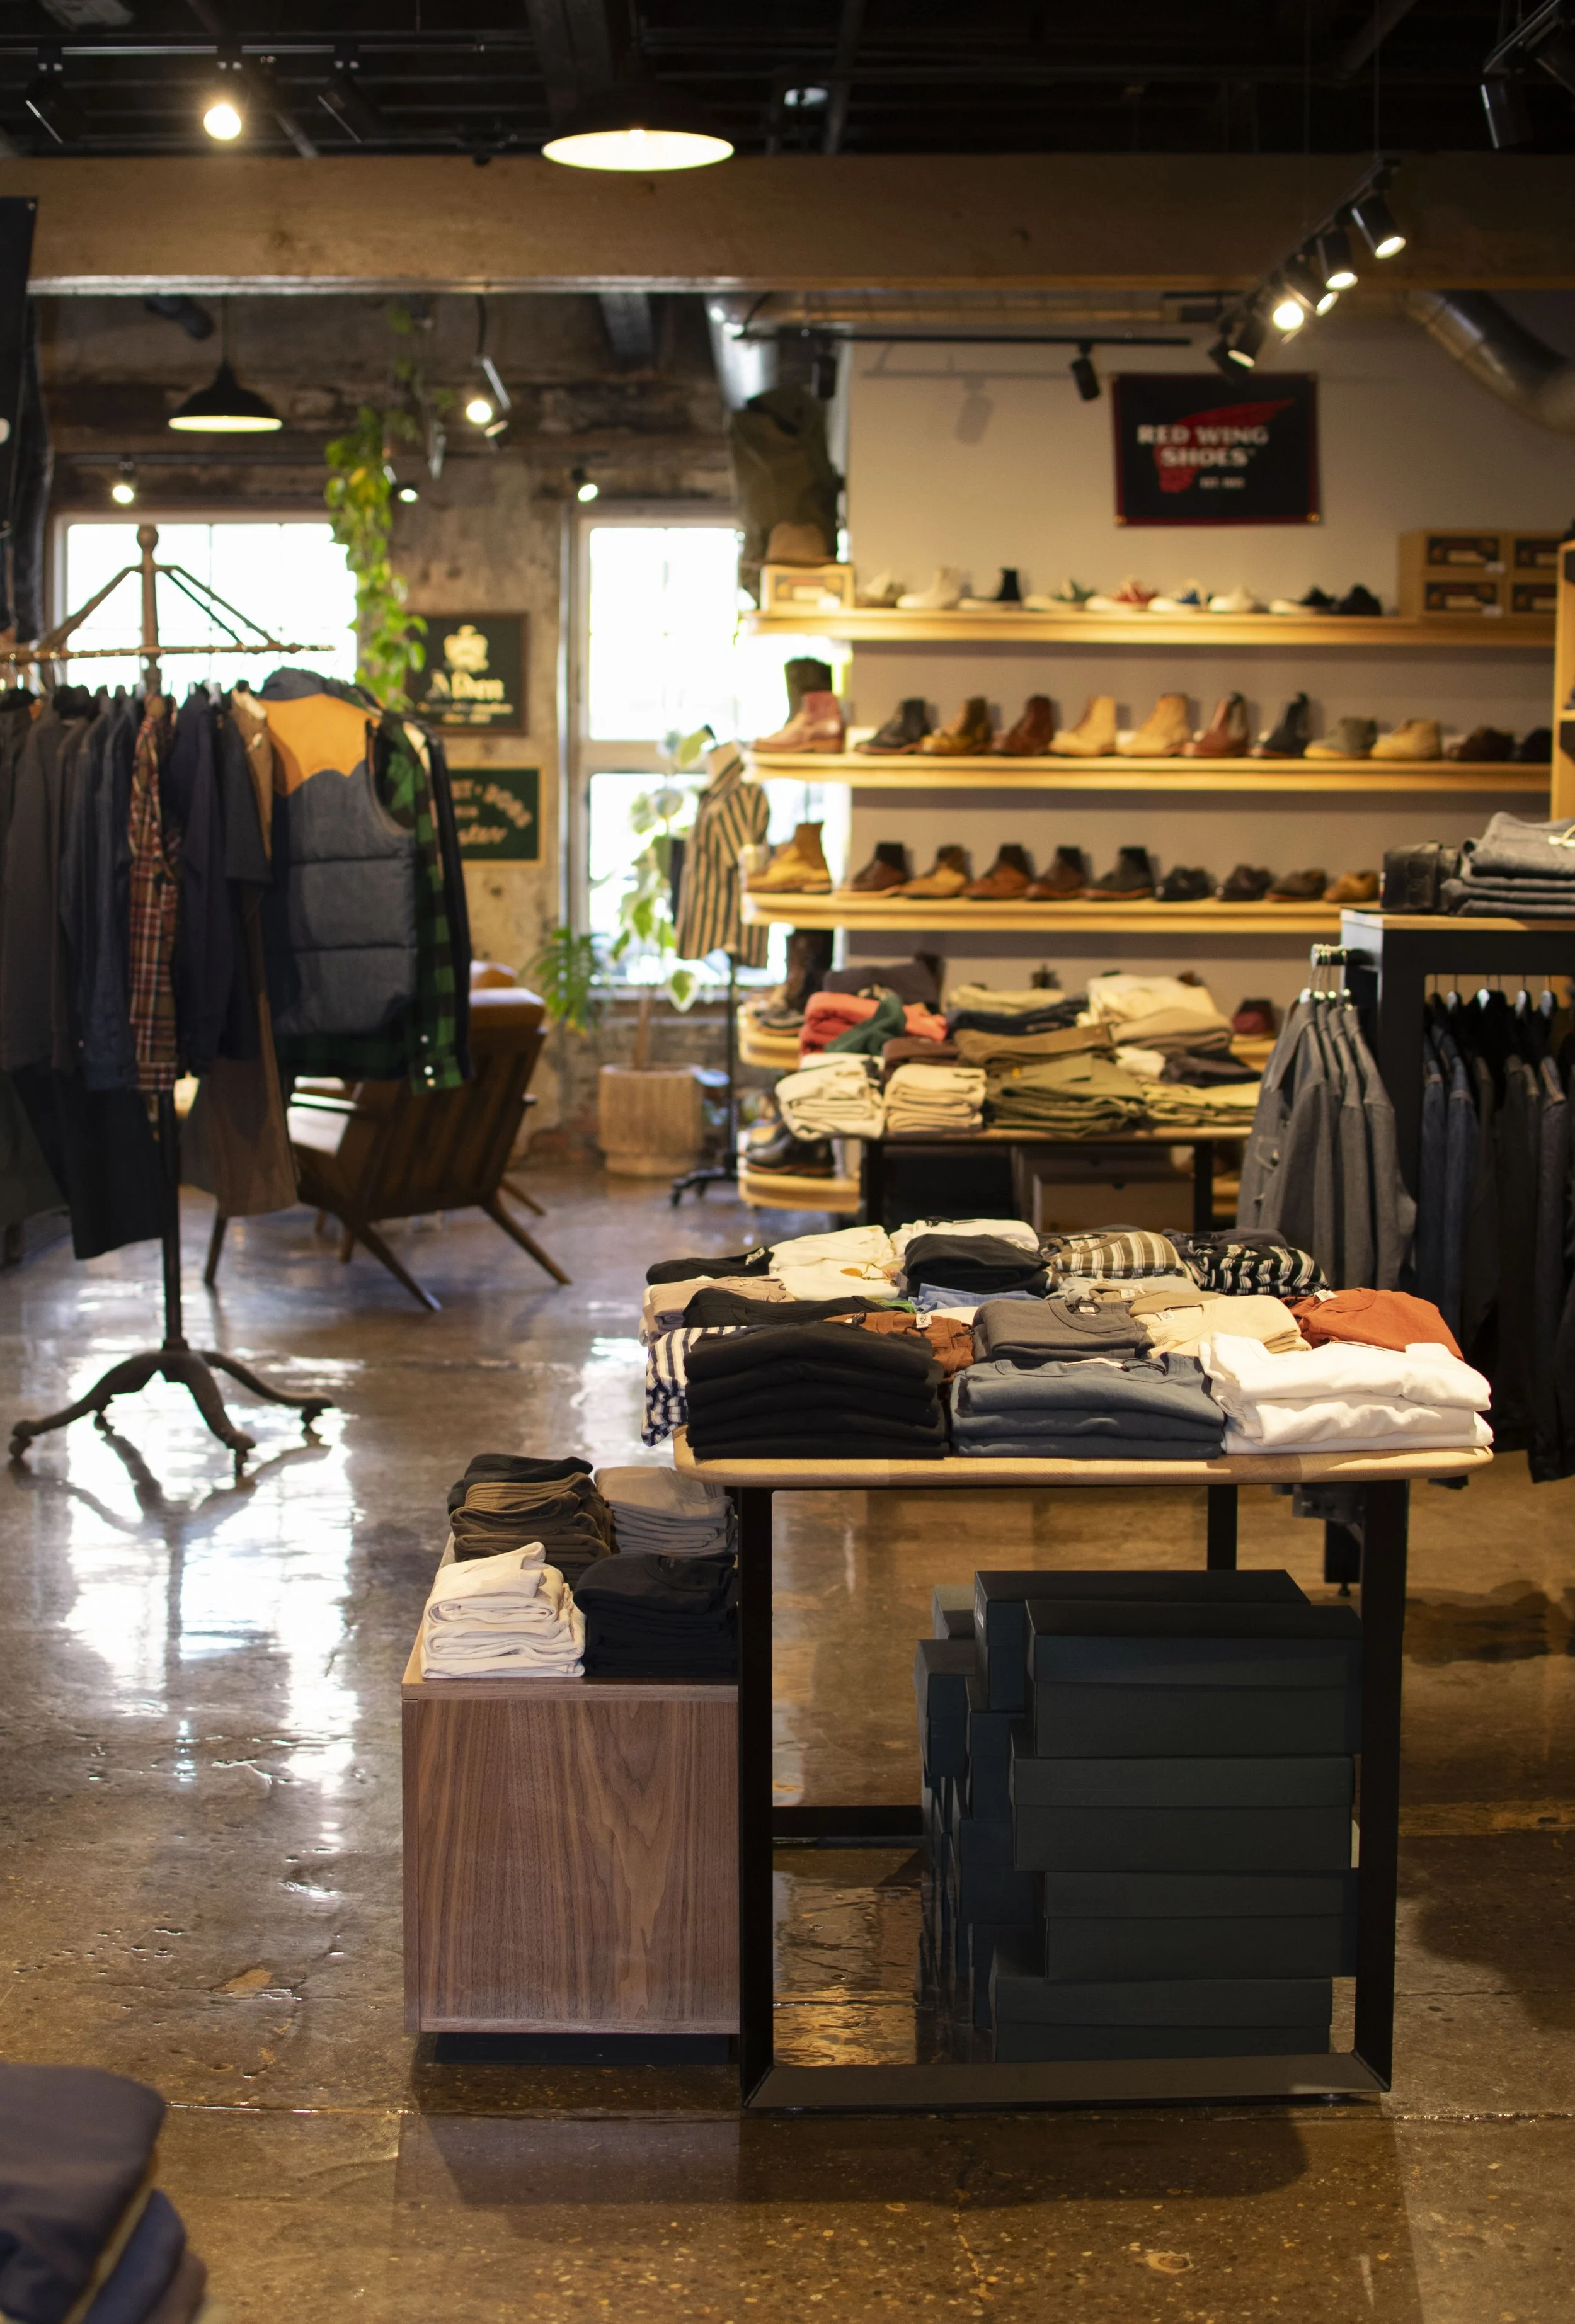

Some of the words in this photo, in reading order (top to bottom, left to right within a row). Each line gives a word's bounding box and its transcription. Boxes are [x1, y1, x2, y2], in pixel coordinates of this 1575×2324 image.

[1137, 425, 1190, 444] RED
[1196, 426, 1268, 445] WING
[1160, 447, 1247, 467] SHOES
